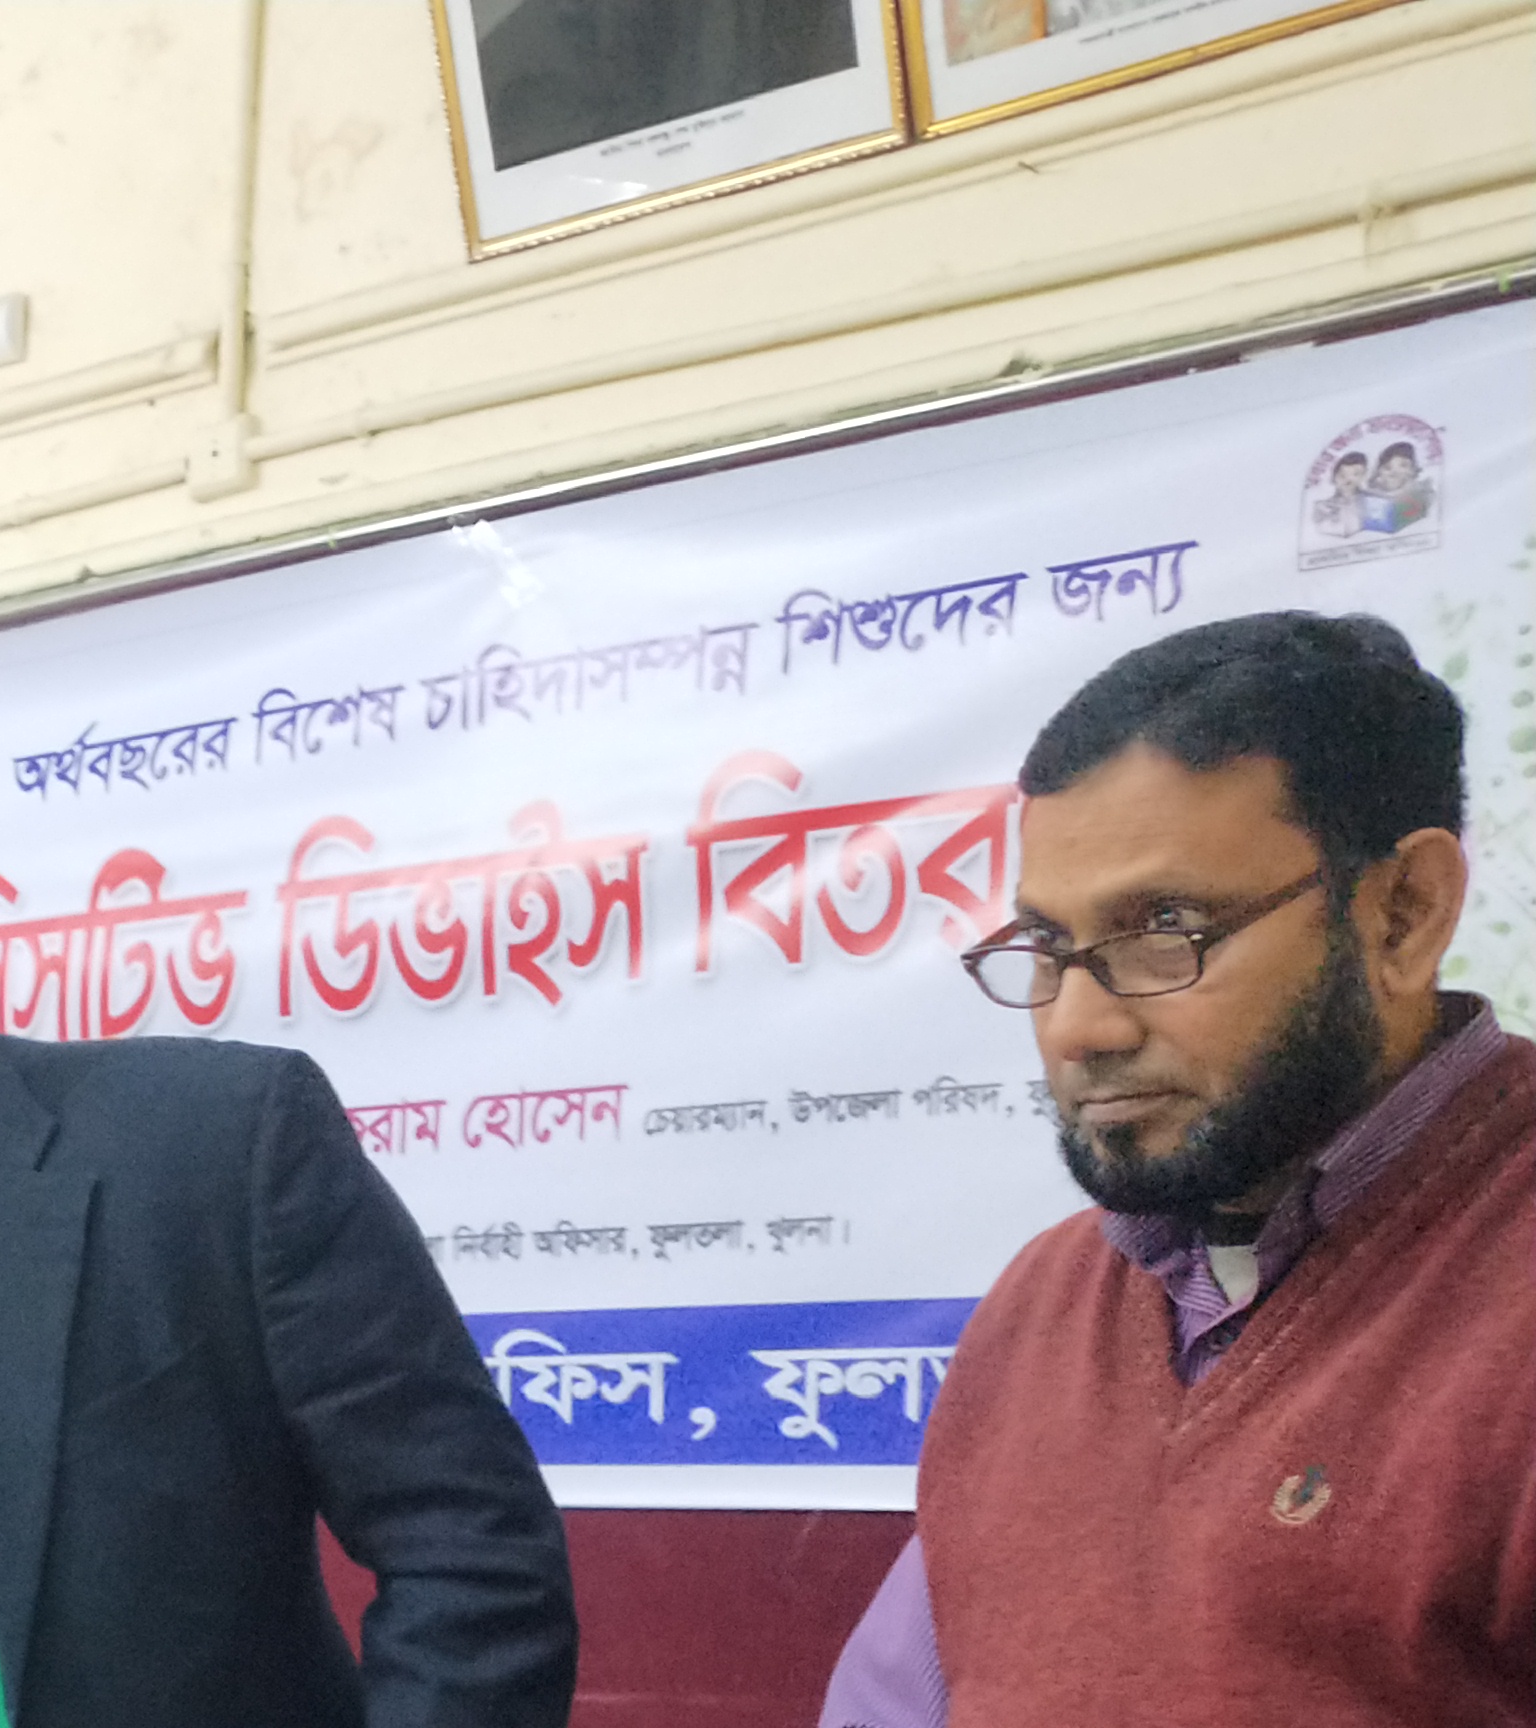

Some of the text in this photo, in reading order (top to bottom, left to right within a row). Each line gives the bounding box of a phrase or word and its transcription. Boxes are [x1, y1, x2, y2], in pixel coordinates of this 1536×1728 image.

[13, 720, 238, 799] অর্থবছরের
[252, 688, 405, 764] বিশেষ
[776, 572, 1028, 674] শিশুদের
[1046, 541, 1199, 621] জন্য
[276, 801, 649, 1018] ডিভাইস
[686, 750, 1020, 972] বিতর
[463, 1083, 629, 1149] হোসেন
[485, 1329, 716, 1440] ফিস,
